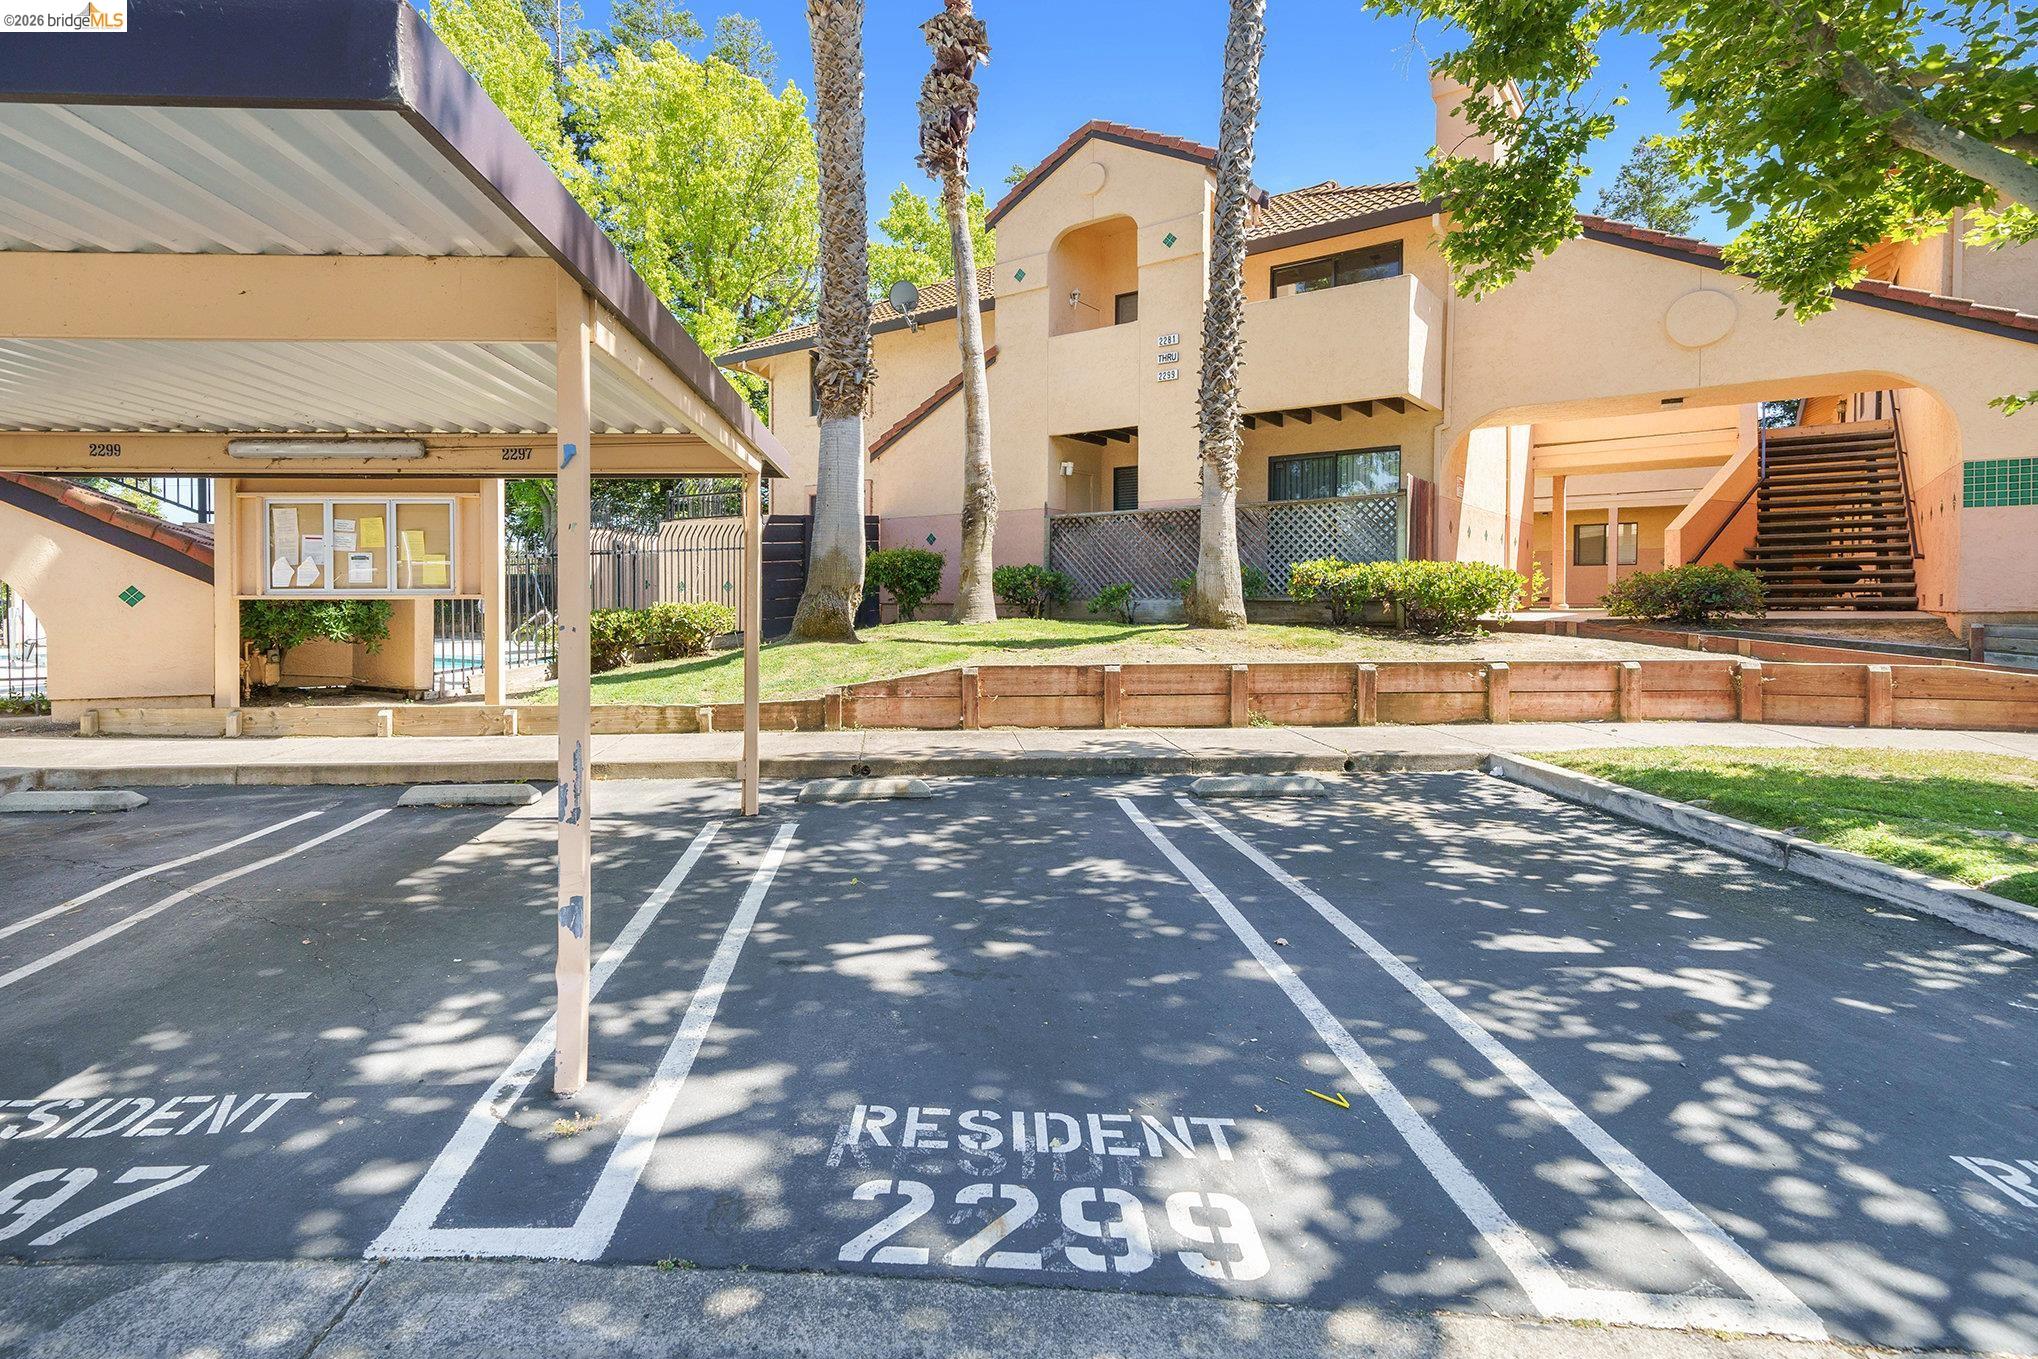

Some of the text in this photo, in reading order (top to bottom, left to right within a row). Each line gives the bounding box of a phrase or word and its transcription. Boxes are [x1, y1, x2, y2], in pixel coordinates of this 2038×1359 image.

[1158, 335, 1176, 346] 2281
[1158, 352, 1177, 362] THRU
[89, 443, 121, 457] 2299
[502, 447, 533, 460] 2297
[844, 1104, 1237, 1162] RESIDENT
[1949, 1155, 2038, 1208] R
[838, 1179, 1272, 1280] 2299
